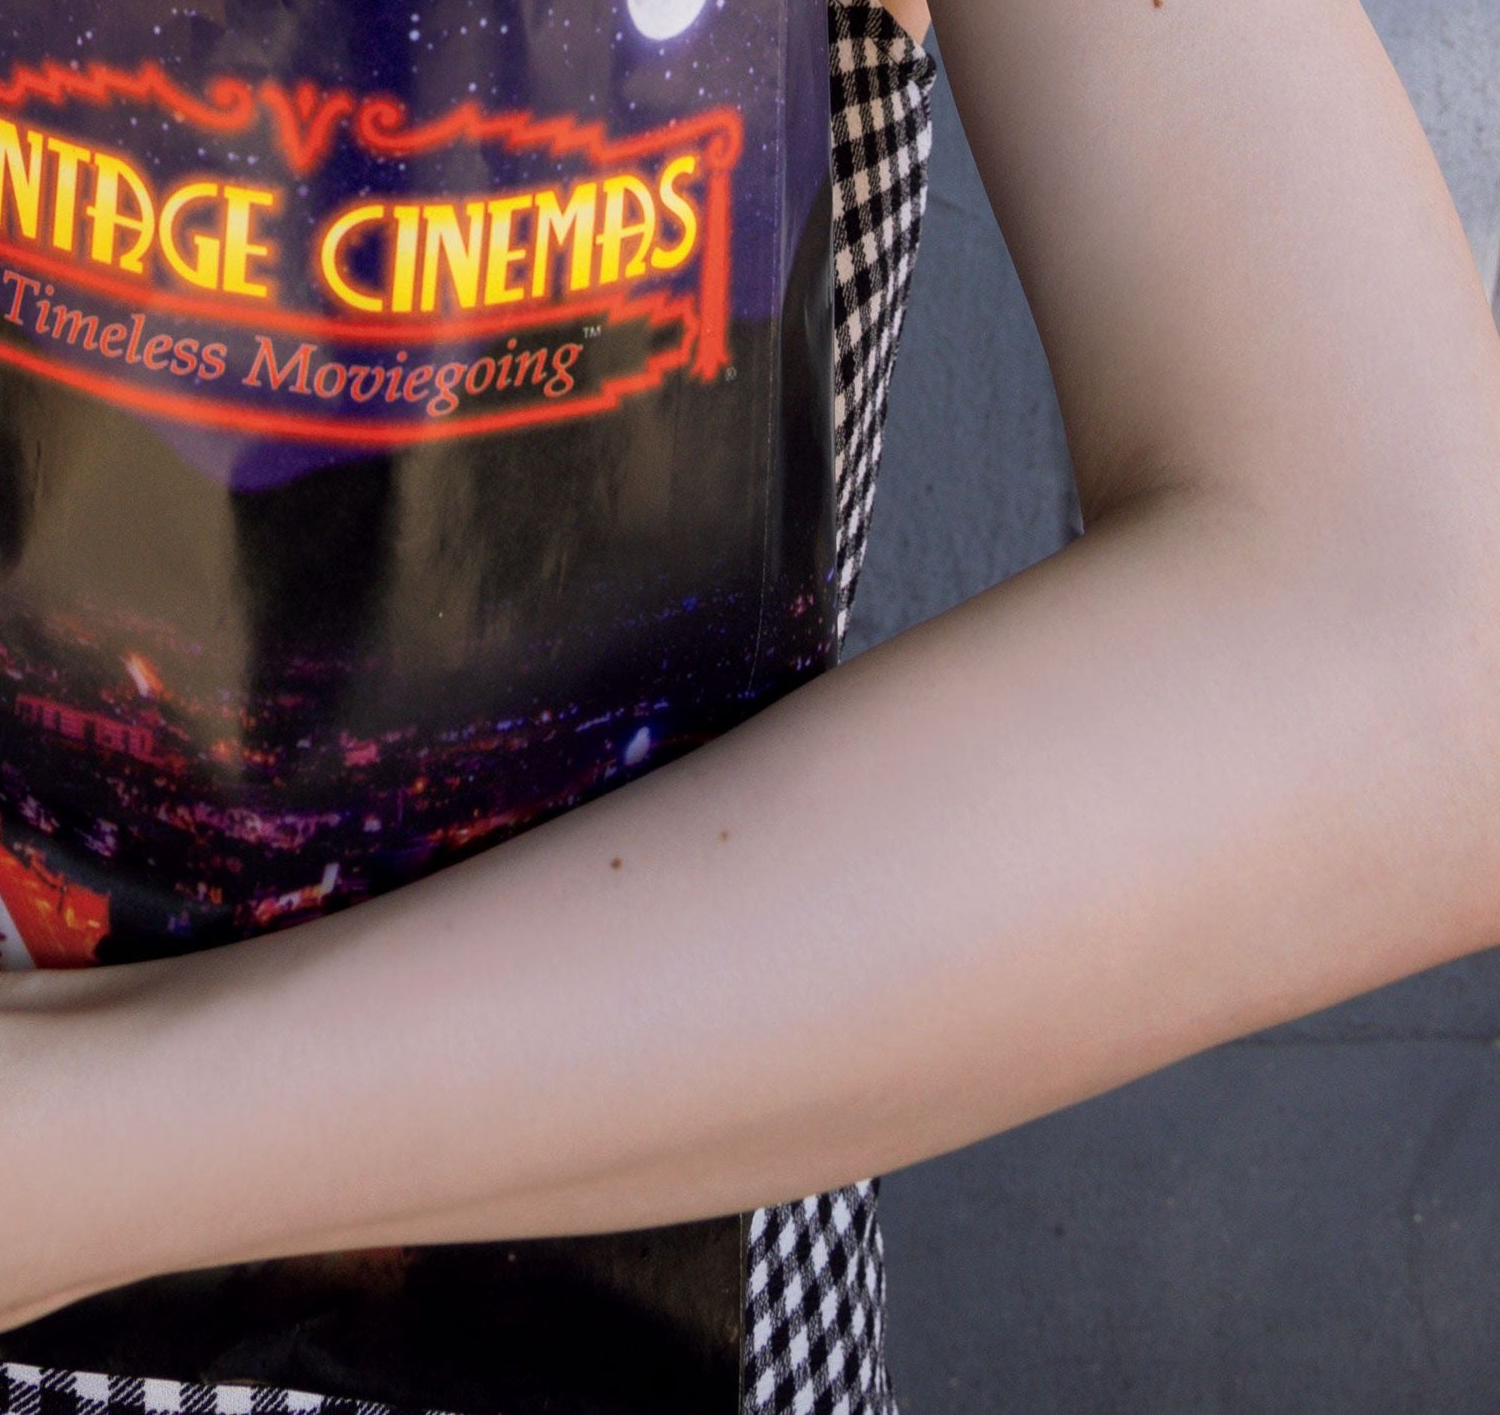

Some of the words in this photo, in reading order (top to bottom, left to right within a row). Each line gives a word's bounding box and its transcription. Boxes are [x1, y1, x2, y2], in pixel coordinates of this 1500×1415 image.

[320, 155, 700, 313] CINEMAS
[2, 270, 228, 381] Timeless
[243, 336, 584, 418] Moviegoing
